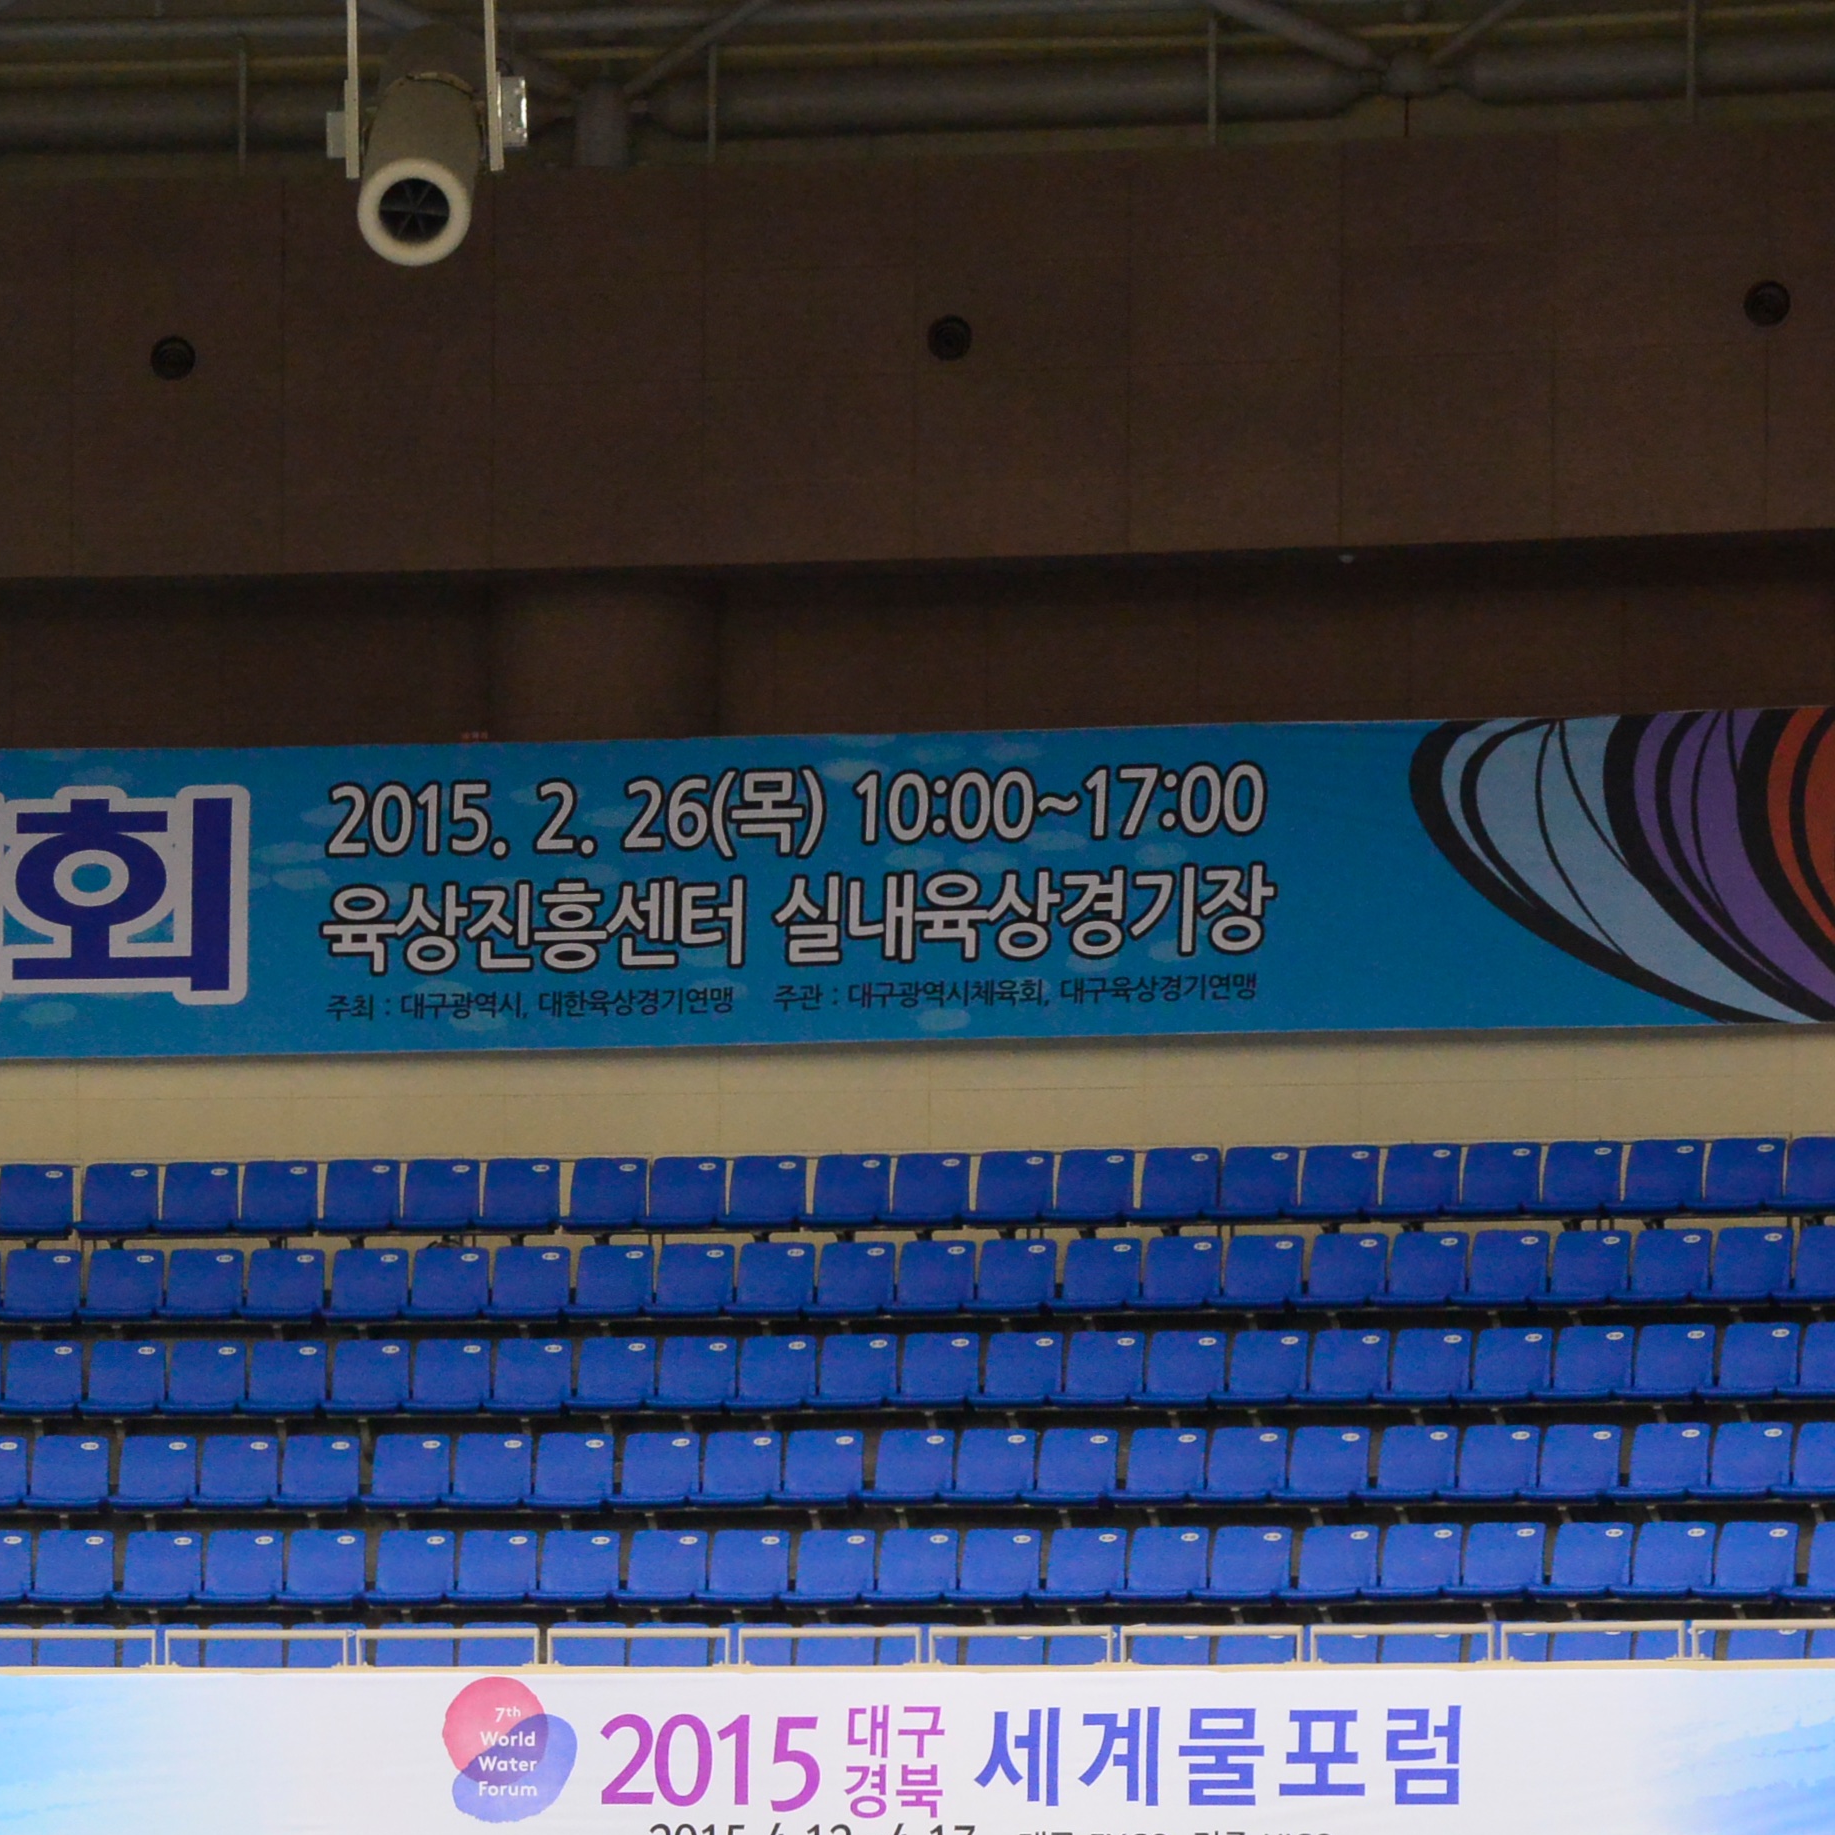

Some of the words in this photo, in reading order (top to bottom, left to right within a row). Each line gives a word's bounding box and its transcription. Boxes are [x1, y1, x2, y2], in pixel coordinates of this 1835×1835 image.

[325, 779, 510, 859] 2015.
[534, 776, 598, 857] 2.
[621, 766, 825, 860] 26(목)
[853, 761, 1266, 844] 10:00~17:00
[320, 872, 747, 976] 육상진흥센터
[772, 861, 1277, 968] 실내육상경기장
[325, 993, 374, 1021] 주최
[401, 991, 529, 1019] 대구광역시,
[538, 985, 734, 1017] 대한육상경기연맹
[774, 983, 821, 1011] 주관
[848, 978, 1051, 1009] 대구광역시체육회,
[1061, 973, 1257, 1006] 대구육상경기연맹
[495, 1706, 521, 1722] 7th
[479, 1730, 537, 1748] World
[600, 1712, 821, 1813] 2015
[846, 1704, 945, 1758] 대구
[973, 1704, 1462, 1807] 세계물포럼
[478, 1756, 538, 1773] Water
[478, 1781, 538, 1798] Forum
[844, 1763, 944, 1819] 경북
